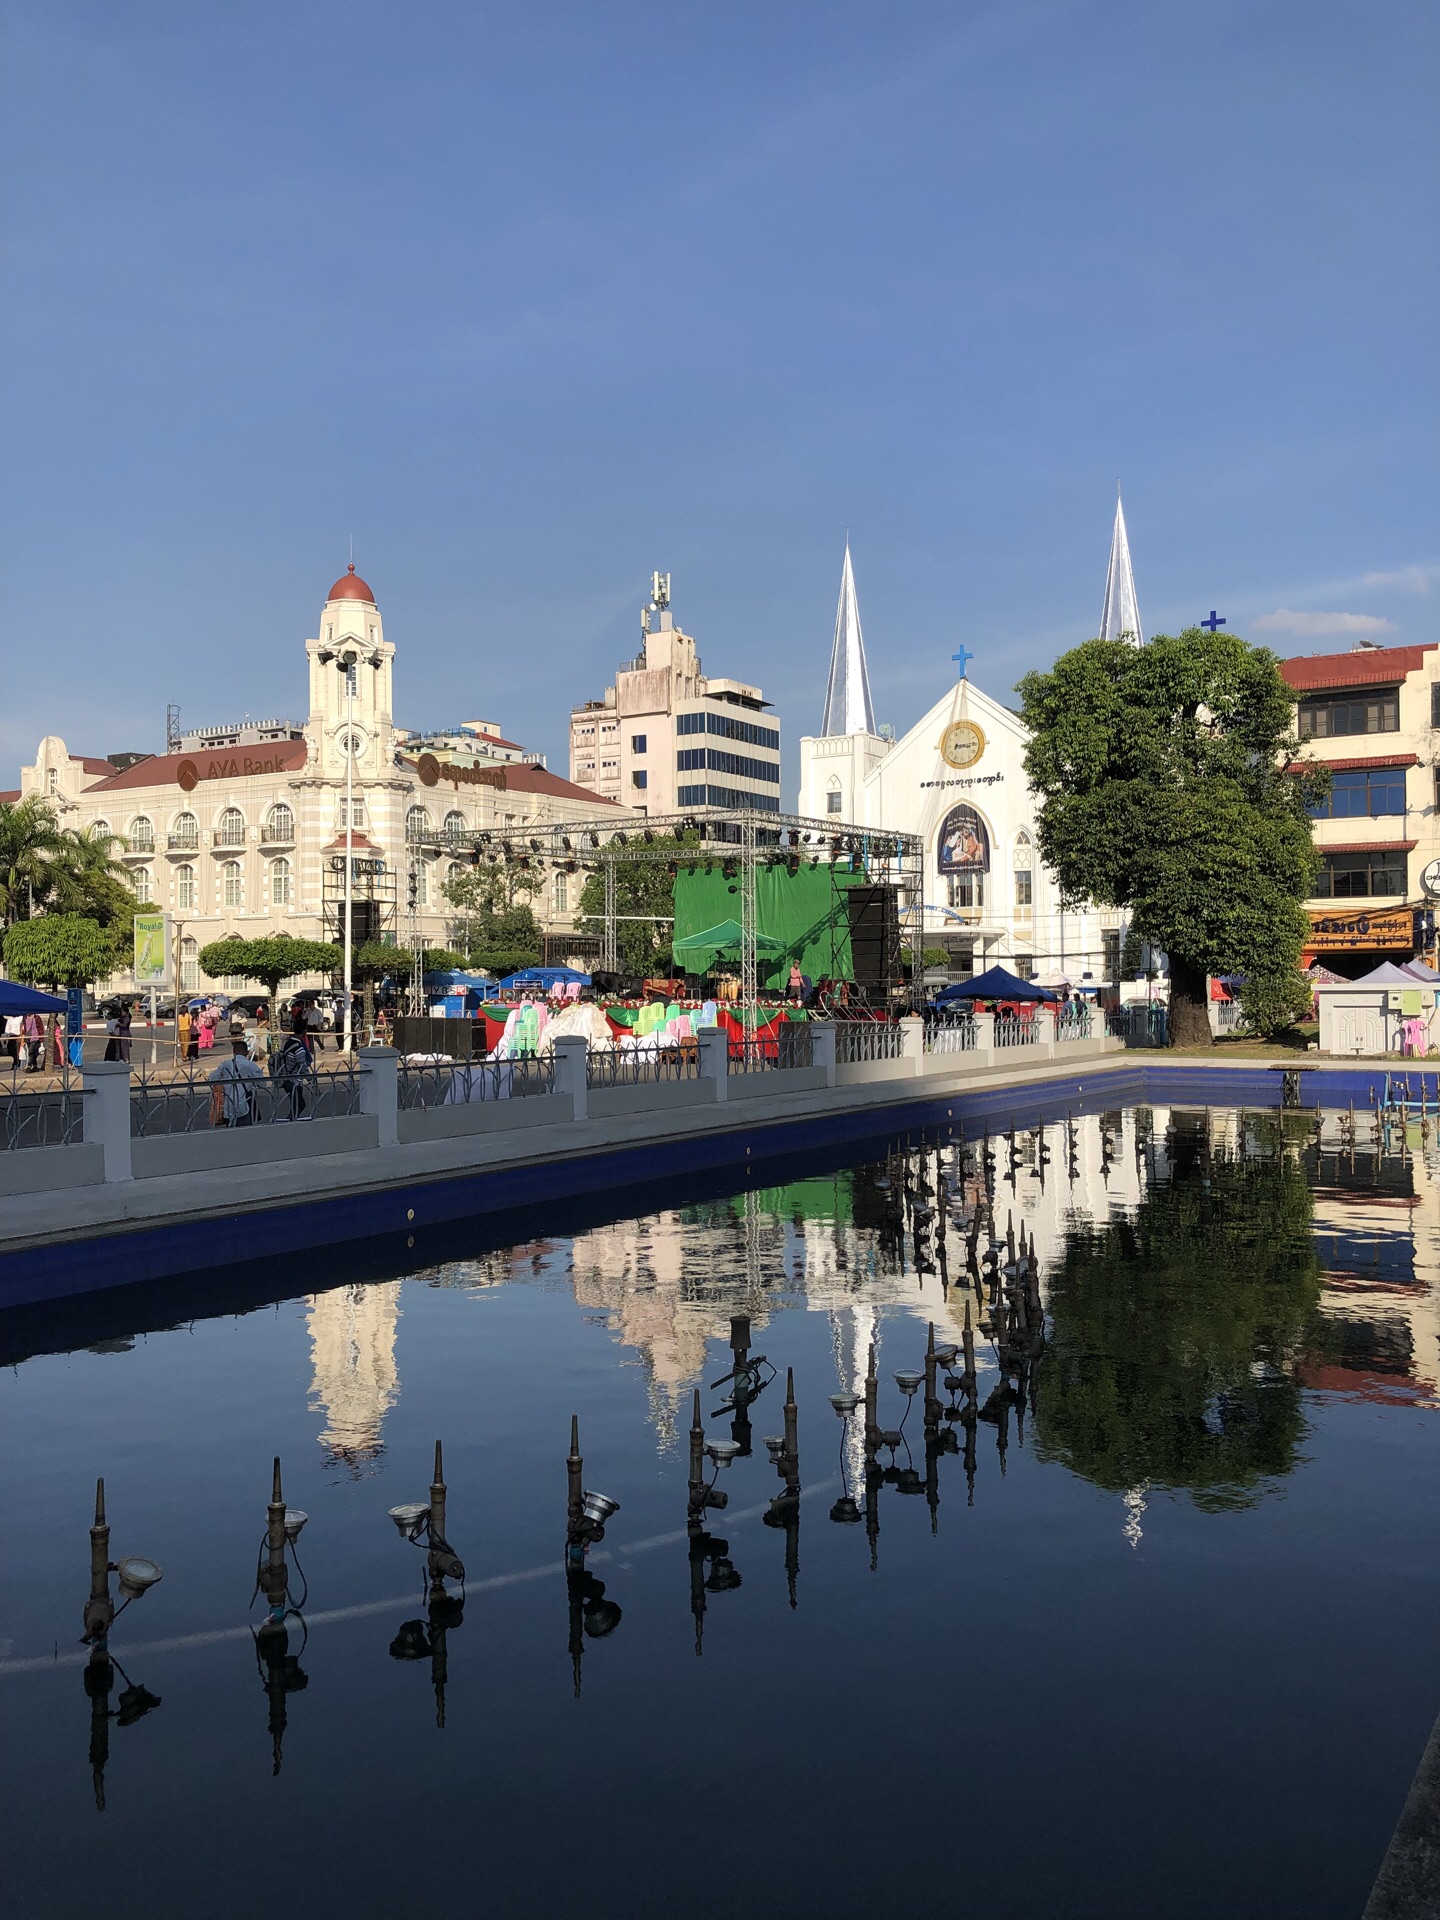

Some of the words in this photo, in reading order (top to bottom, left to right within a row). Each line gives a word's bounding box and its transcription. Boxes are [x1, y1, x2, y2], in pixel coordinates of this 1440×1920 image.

[207, 758, 240, 780] AYA
[243, 754, 285, 775] Bank
[139, 921, 163, 931] Royal-D
